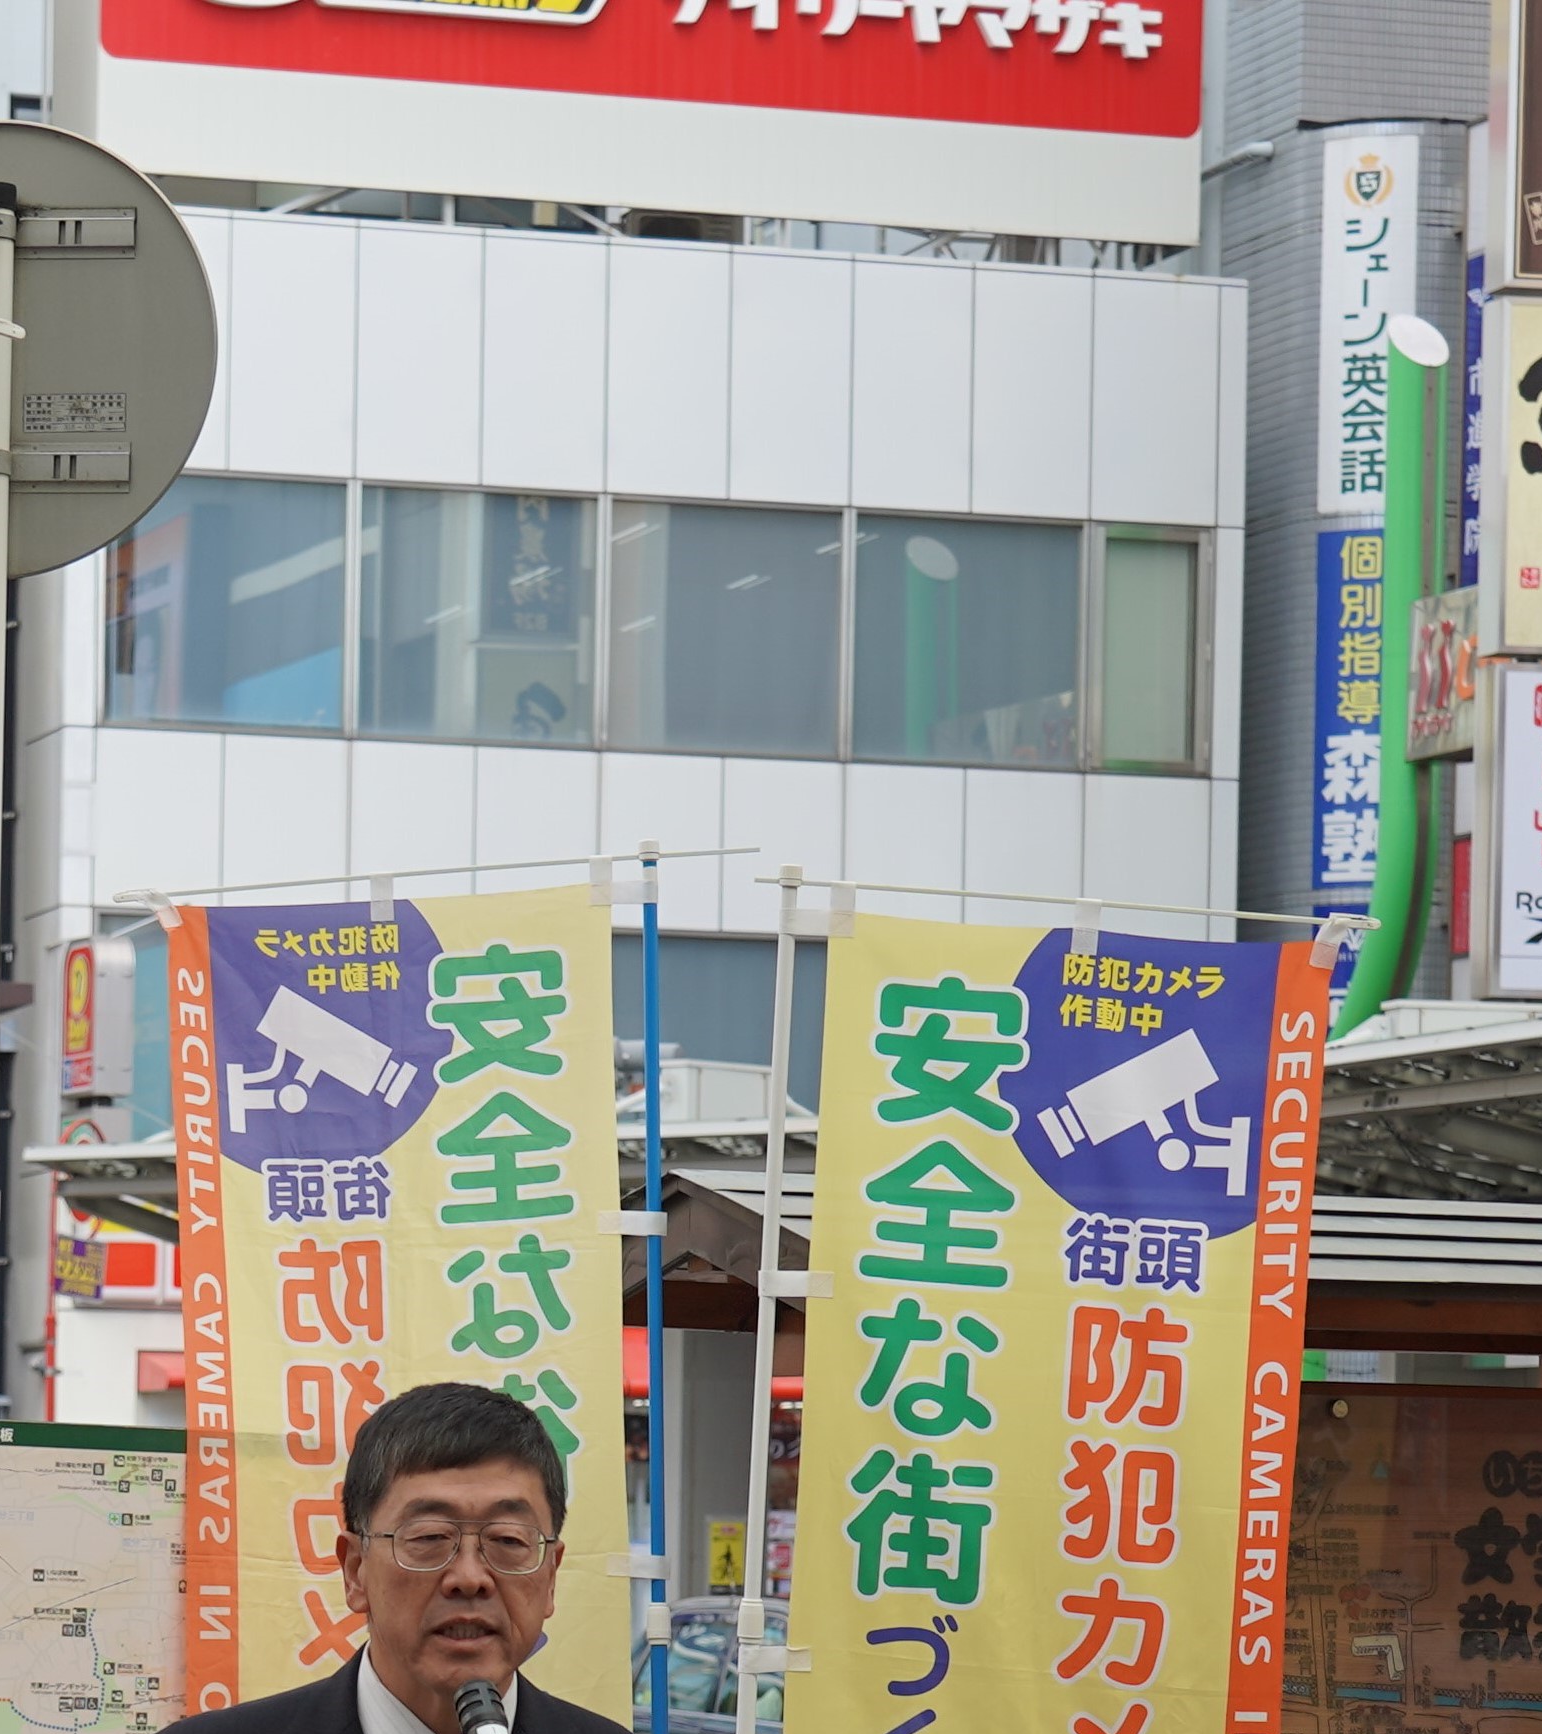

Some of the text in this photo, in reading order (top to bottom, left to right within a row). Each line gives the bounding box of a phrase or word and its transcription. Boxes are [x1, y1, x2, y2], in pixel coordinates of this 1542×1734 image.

[1340, 217, 1390, 494] シェーン英会話
[1338, 535, 1383, 724] 個別指導
[1060, 994, 1164, 1036] 作動中
[1061, 953, 1226, 999] 防犯カメラ
[1063, 1217, 1204, 1294] 街頭
[1258, 1010, 1316, 1321] SECURITY
[1237, 1360, 1290, 1667] CAMERAS
